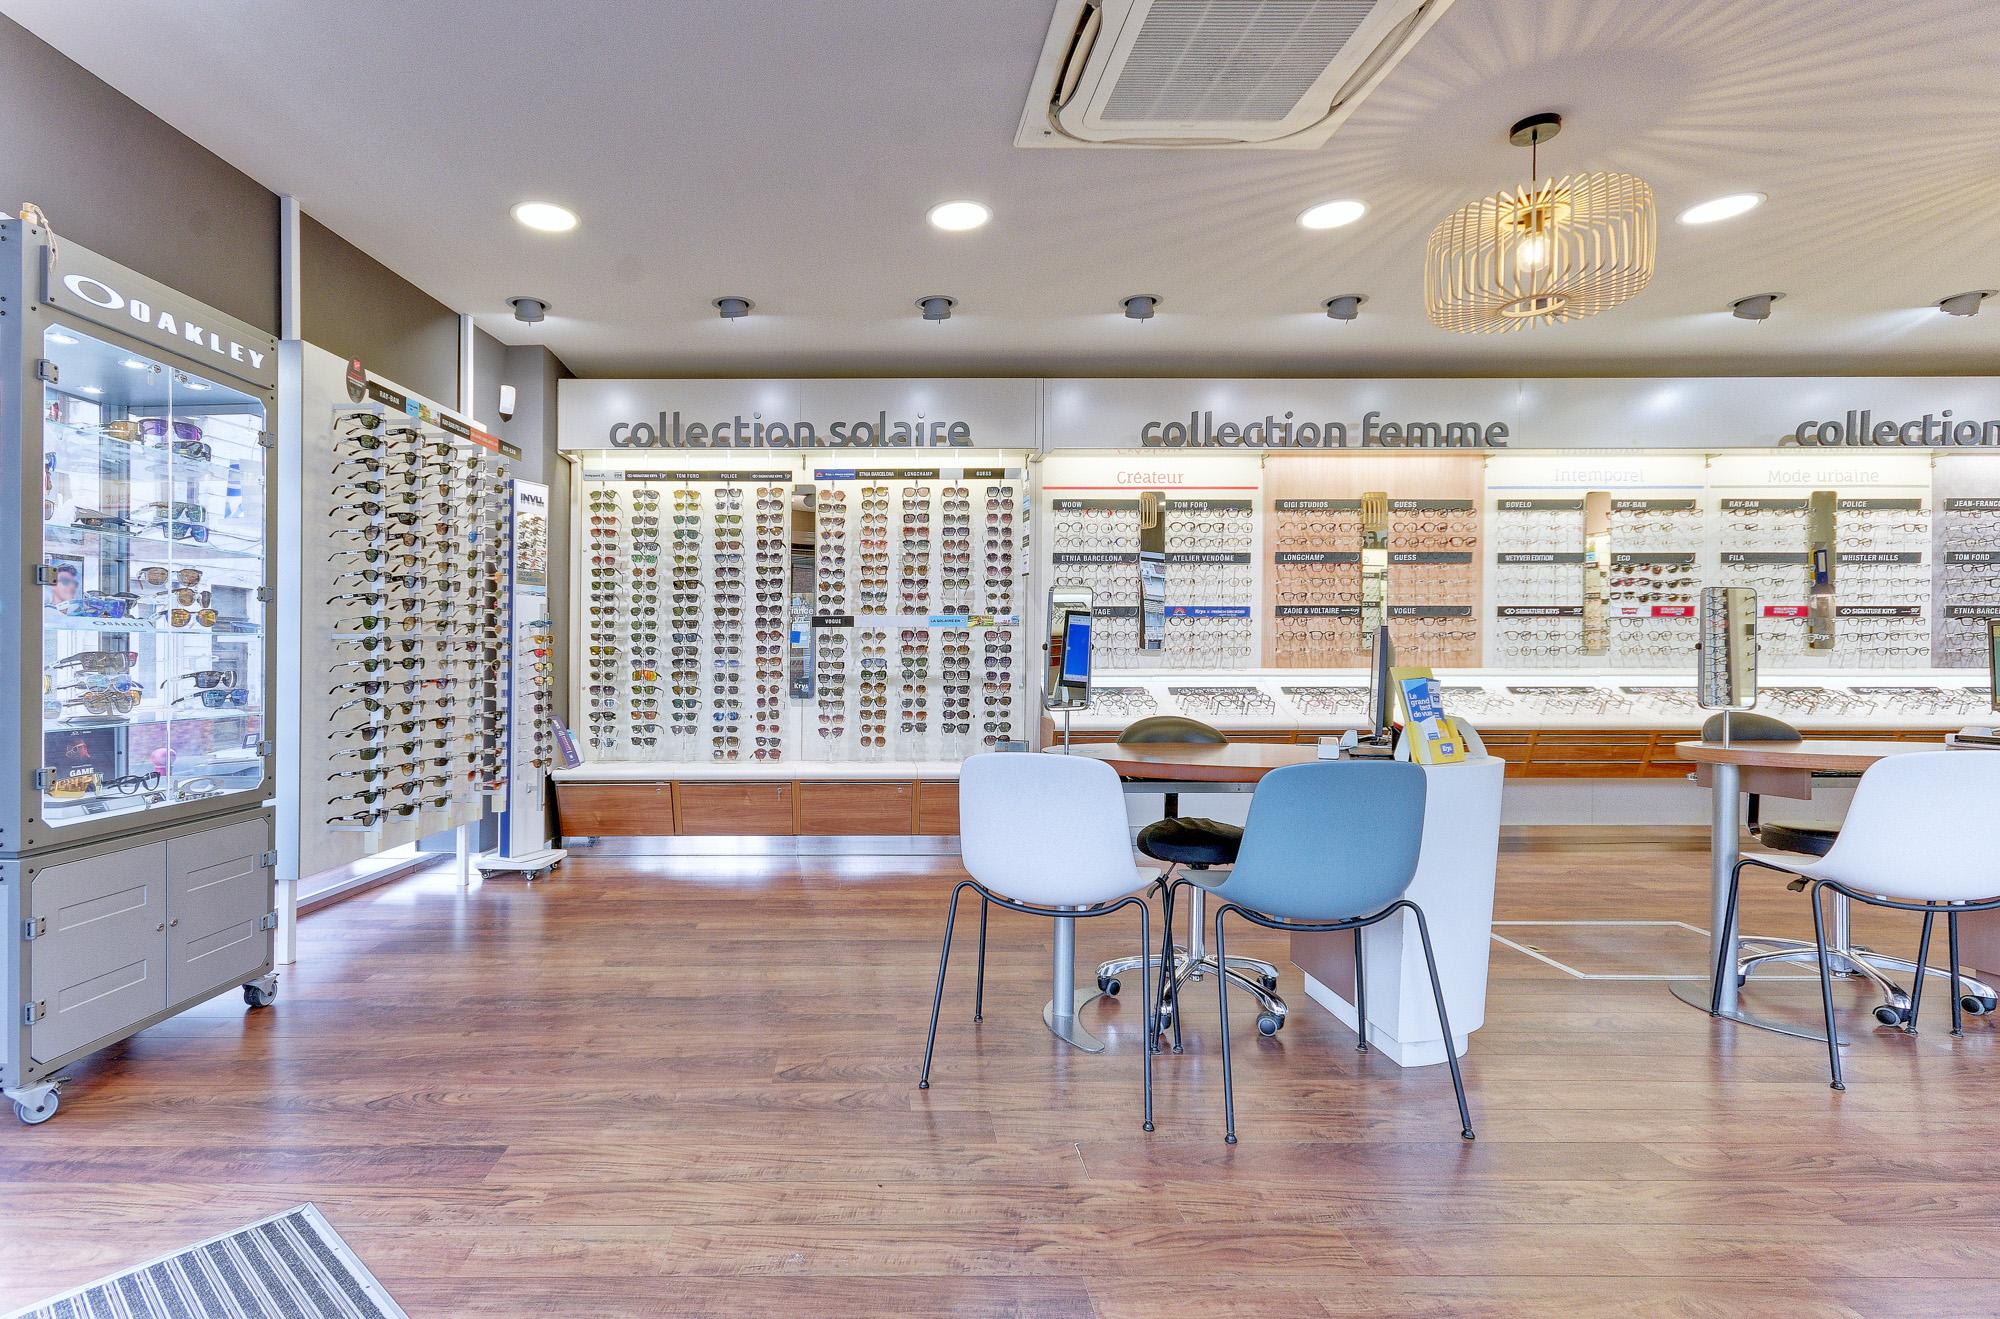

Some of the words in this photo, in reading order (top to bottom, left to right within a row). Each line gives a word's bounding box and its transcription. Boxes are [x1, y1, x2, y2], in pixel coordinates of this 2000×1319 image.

[130, 300, 264, 369] OAKLEY
[609, 411, 815, 448] collection
[829, 411, 971, 448] solaire
[1141, 411, 1347, 448] collection
[1362, 411, 1510, 448] femme
[1117, 470, 1185, 484] Créateur
[1554, 468, 1645, 484] Intemporel
[1768, 469, 1811, 483] Mode
[1817, 469, 1880, 483] urbaine
[1202, 553, 1234, 562] VENDÔME
[793, 682, 809, 691] Krys
[1410, 698, 1430, 707] grand
[69, 767, 95, 778] GAME
